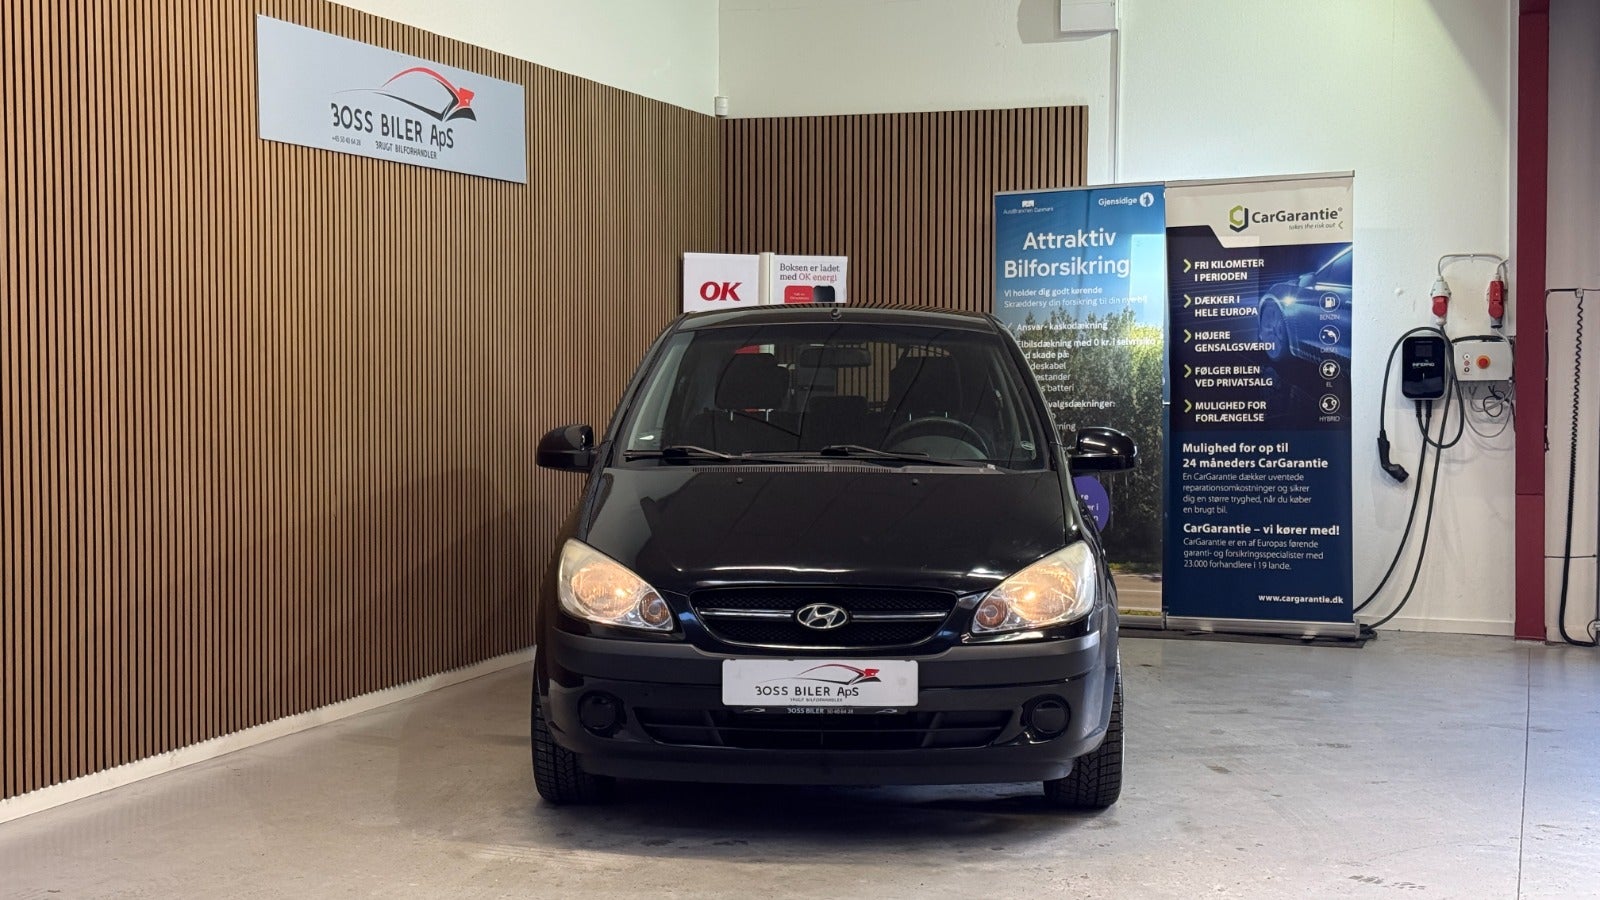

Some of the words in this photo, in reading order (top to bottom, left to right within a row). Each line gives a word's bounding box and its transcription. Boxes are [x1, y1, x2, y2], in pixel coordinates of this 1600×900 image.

[381, 114, 422, 143] BILER
[430, 124, 454, 152] ApS
[1098, 197, 1138, 206] Gjensidige
[1023, 228, 1116, 250] Attraktiv
[780, 263, 808, 272] Boksen
[820, 264, 840, 272] ladet
[1004, 256, 1130, 278] Bilforsikring
[1195, 261, 1208, 269] FRI
[1211, 259, 1264, 269] KILOMETER
[812, 274, 837, 283] energi
[1200, 272, 1247, 281] PERIODEN
[700, 281, 742, 301] OK
[1038, 288, 1050, 297] dig
[1052, 288, 1070, 297] godt
[1071, 287, 1102, 295] kørende
[1004, 299, 1047, 308] Skræddersy
[1062, 297, 1097, 306] forsikring
[1195, 296, 1235, 305] DÆKKER
[1195, 309, 1218, 317] HELE
[1220, 307, 1258, 316] EUROPA
[1049, 322, 1108, 332] kaskodækning
[1195, 331, 1230, 340] HØJERE
[1074, 339, 1092, 347] med
[1195, 342, 1275, 352] GENSALGSVÆRDI
[1195, 366, 1231, 375] FØLGER
[1234, 366, 1260, 375] BILEN
[1195, 379, 1214, 387] VED
[1216, 378, 1273, 387] PRIVATSALG
[1196, 402, 1245, 410] MULIGHED
[1248, 401, 1266, 409] FOR
[1196, 414, 1264, 422] FORLÆNGELSE
[1183, 443, 1236, 455] Mulighed
[1239, 443, 1256, 452] for
[1258, 445, 1274, 455] op
[1277, 443, 1288, 452] til
[1183, 459, 1196, 467] 24
[1199, 458, 1256, 468] måneders
[1258, 458, 1328, 468] CarGarantie
[1183, 484, 1275, 493] reparationsomkostninger
[1183, 495, 1195, 504] dig
[1231, 496, 1262, 504] tryghed,
[1194, 506, 1215, 515] brugt
[1183, 524, 1251, 533] CarGarantie
[1263, 525, 1273, 534] vi
[1277, 525, 1307, 534] kører
[1310, 525, 1339, 535] med!
[1257, 539, 1287, 548] Europas
[1288, 540, 1318, 548] førende
[1183, 550, 1212, 558] garanti-
[1225, 550, 1304, 560] forsikringsspecialister
[1209, 560, 1252, 568] forhandlere
[1268, 562, 1291, 570] lande.
[1258, 594, 1343, 604] www.cargarantie.dk
[794, 686, 830, 696] BILER
[837, 686, 859, 698] ApS
